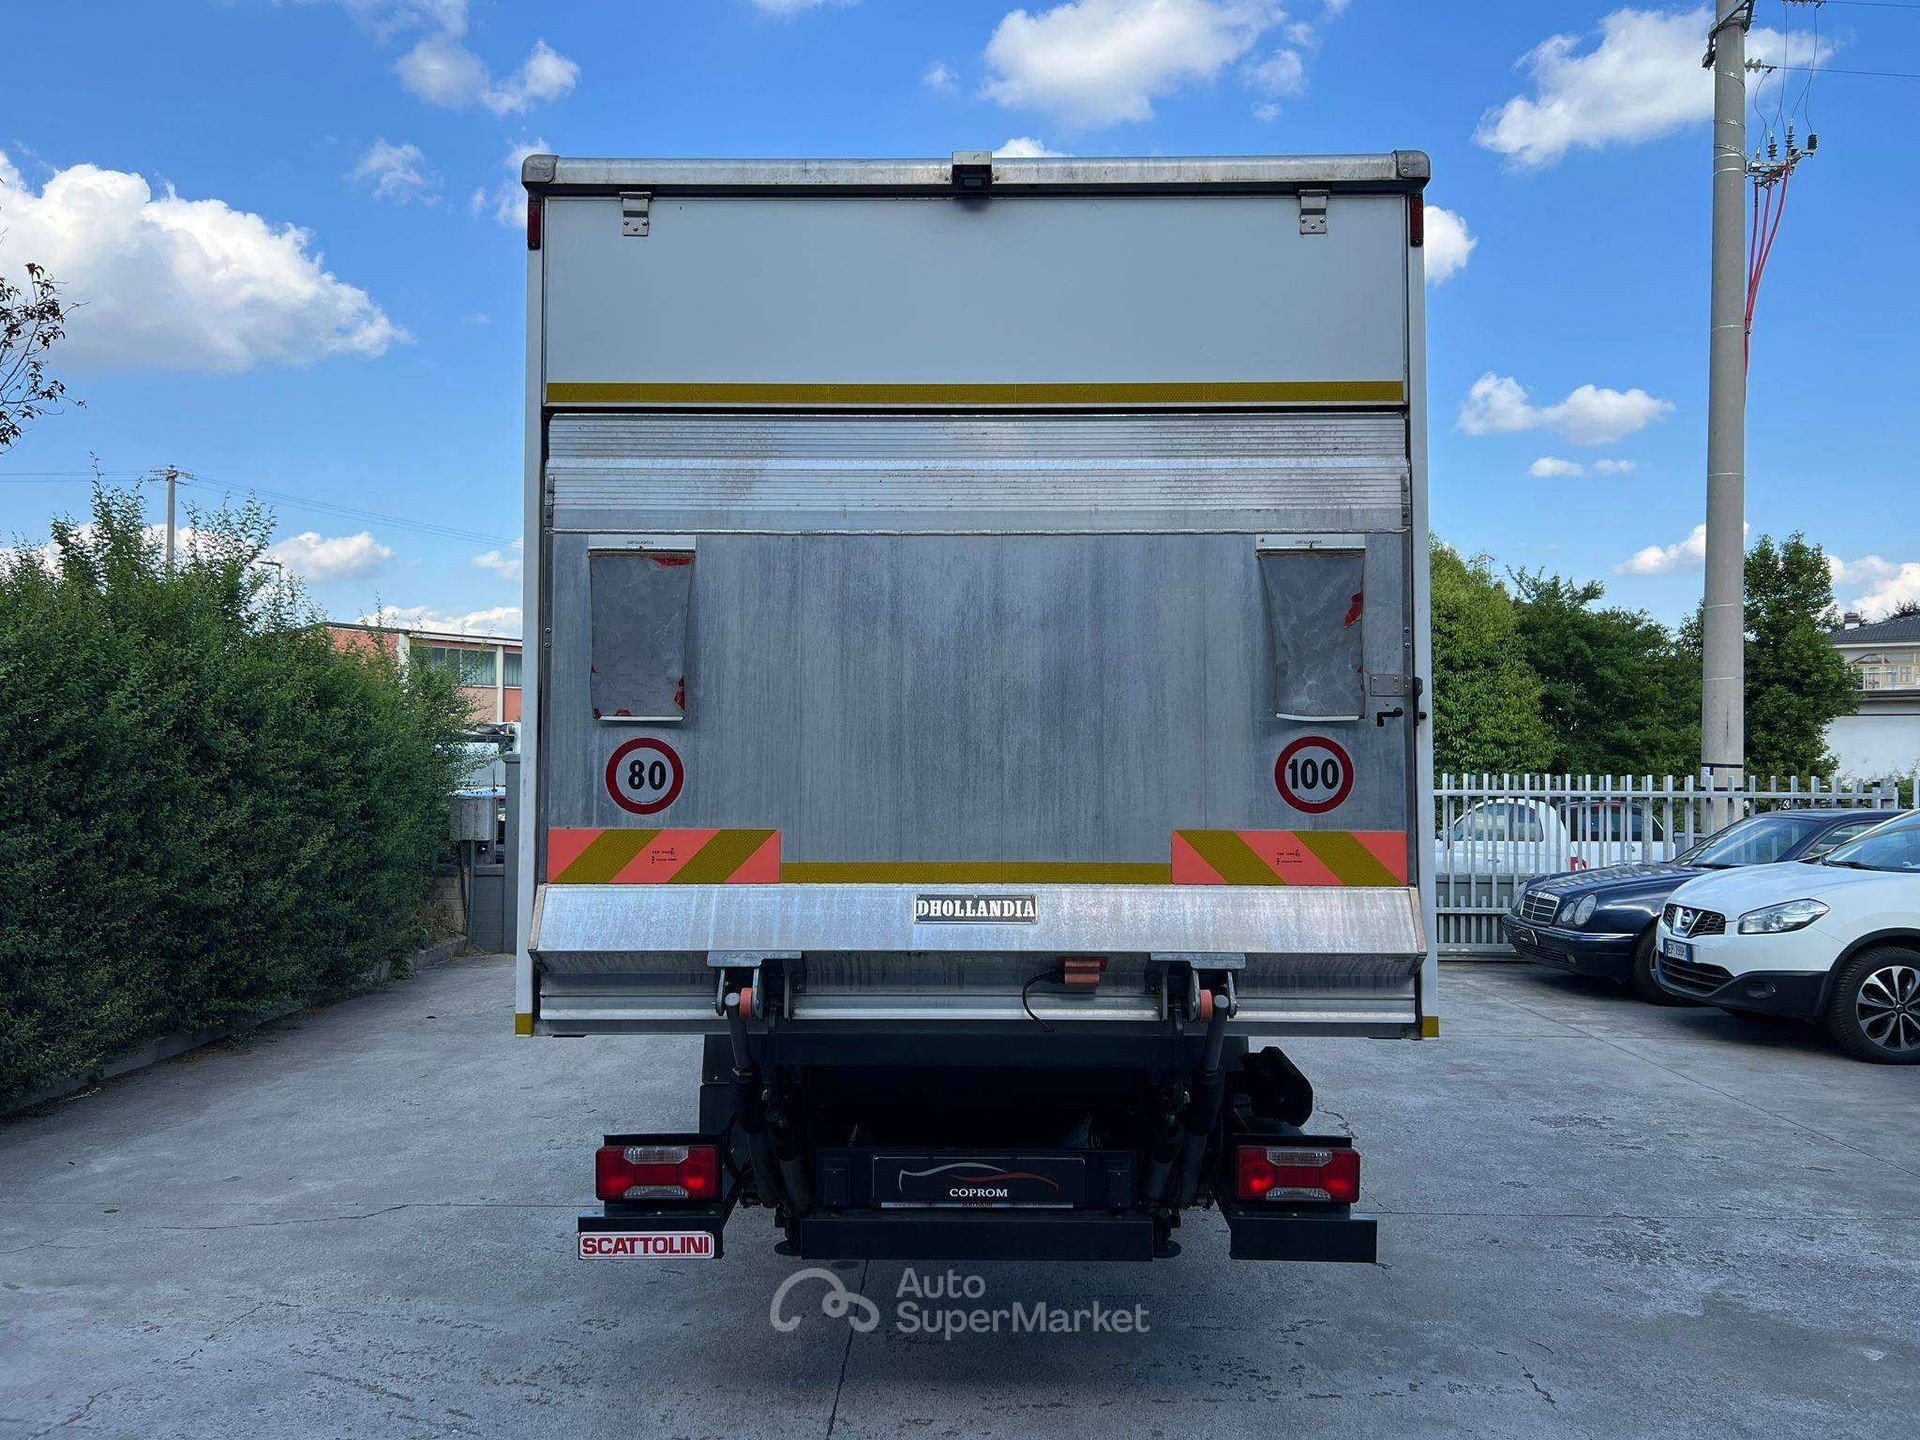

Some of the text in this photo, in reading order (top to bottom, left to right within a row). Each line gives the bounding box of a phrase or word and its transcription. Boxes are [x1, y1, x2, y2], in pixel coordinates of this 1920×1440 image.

[628, 759, 667, 790] 80
[1288, 758, 1340, 790] 100
[916, 899, 1036, 918] DHOLLANDIA
[949, 1188, 1008, 1198] COPROM
[582, 1236, 710, 1255] SCATTOLINI
